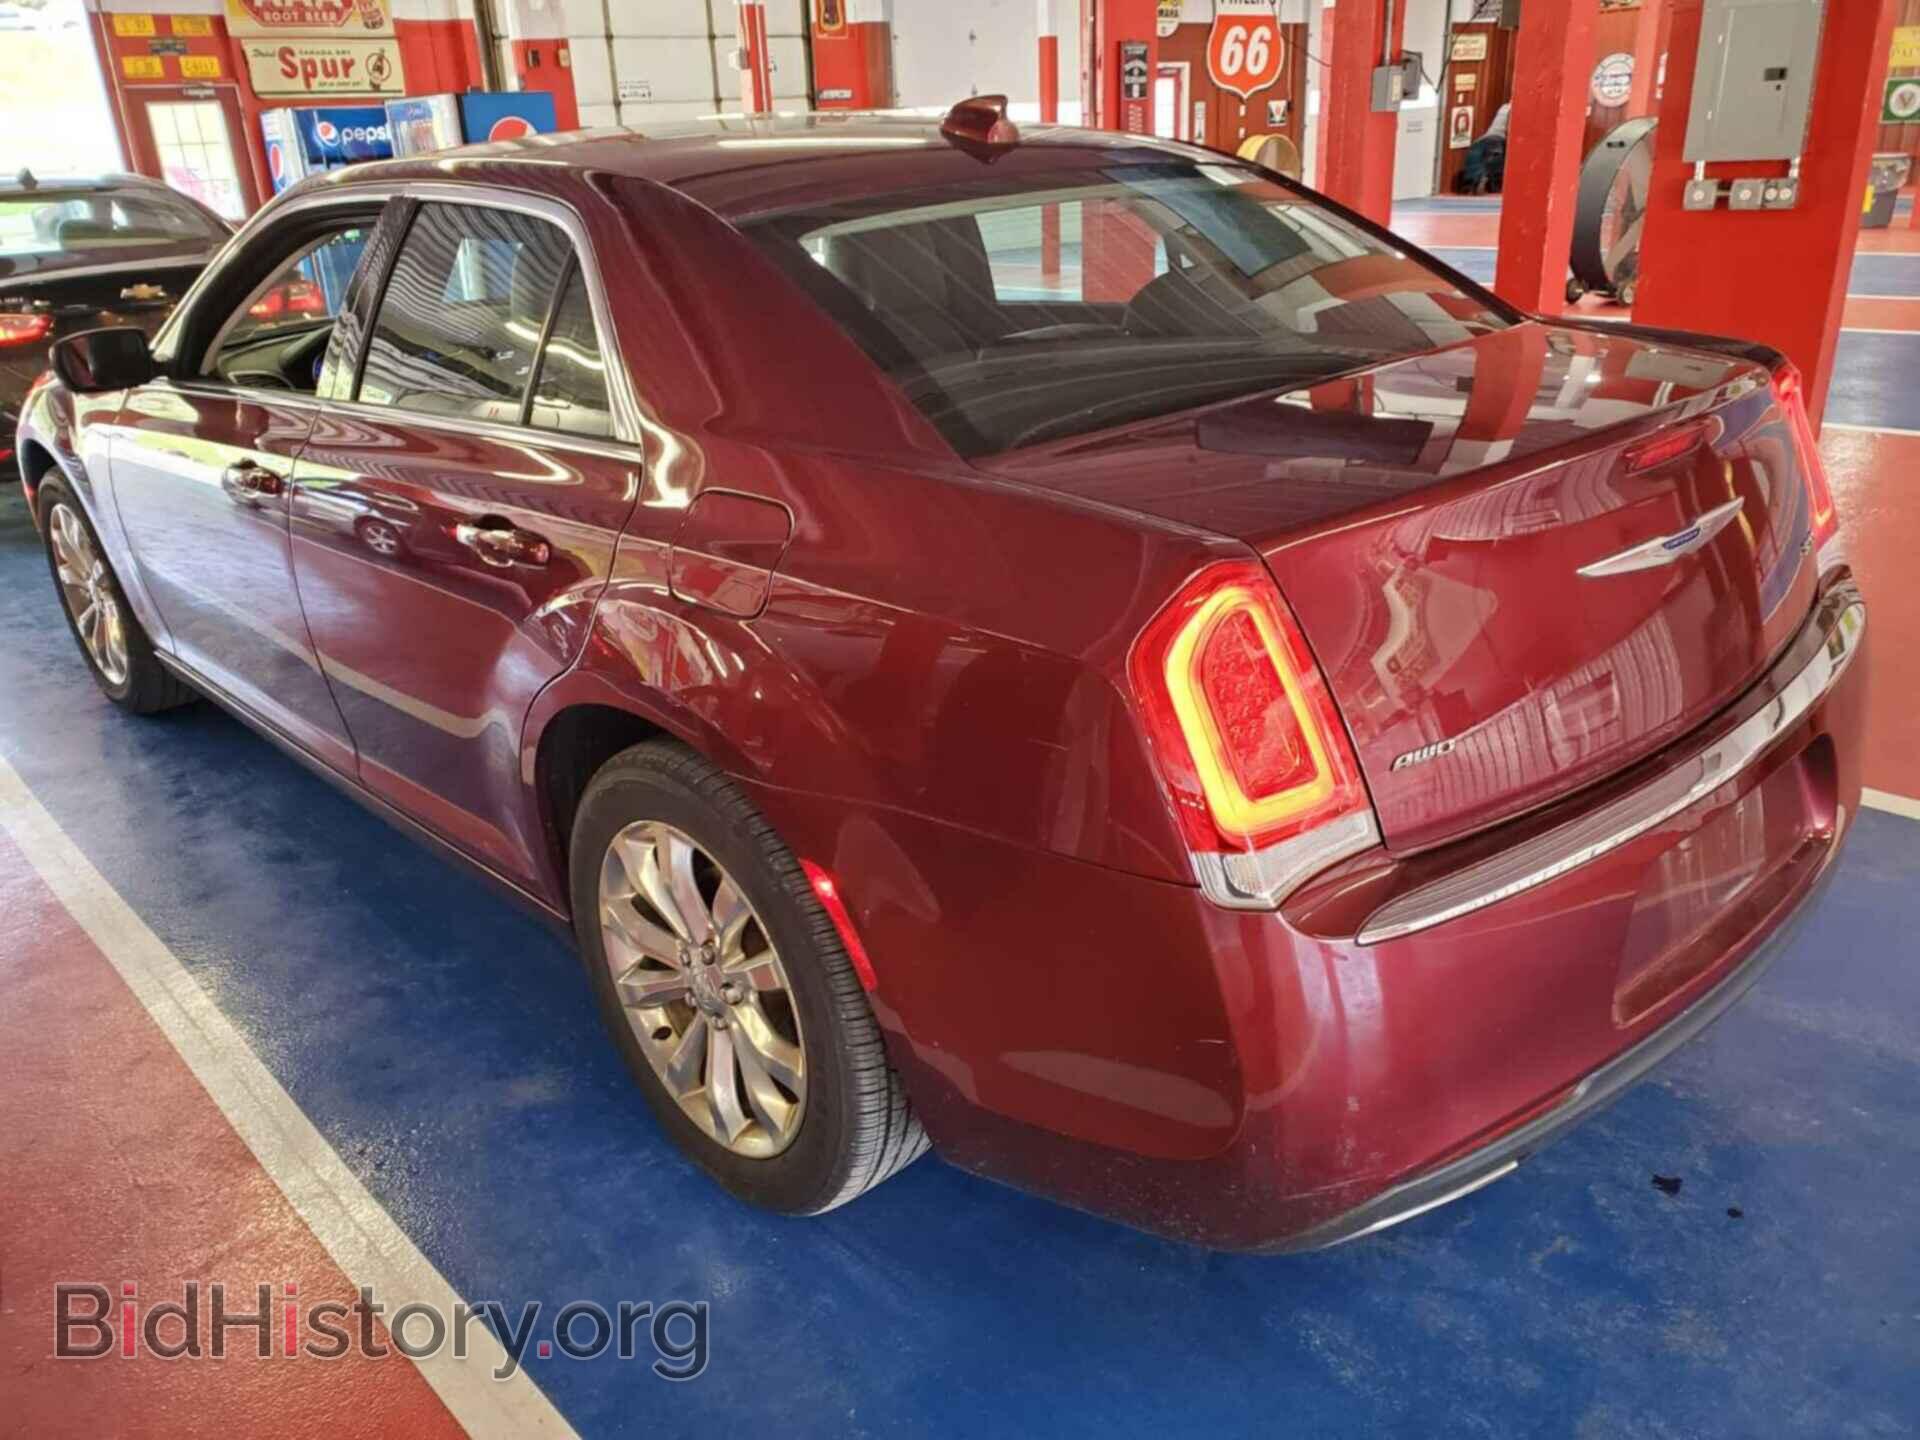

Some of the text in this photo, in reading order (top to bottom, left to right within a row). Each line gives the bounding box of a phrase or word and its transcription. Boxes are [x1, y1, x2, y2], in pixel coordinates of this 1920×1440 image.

[263, 11, 337, 21] ROOT BEER
[1220, 25, 1272, 76] 66
[278, 46, 356, 90] Spur
[342, 123, 392, 145] pepsi
[1390, 739, 1456, 772] AWD
